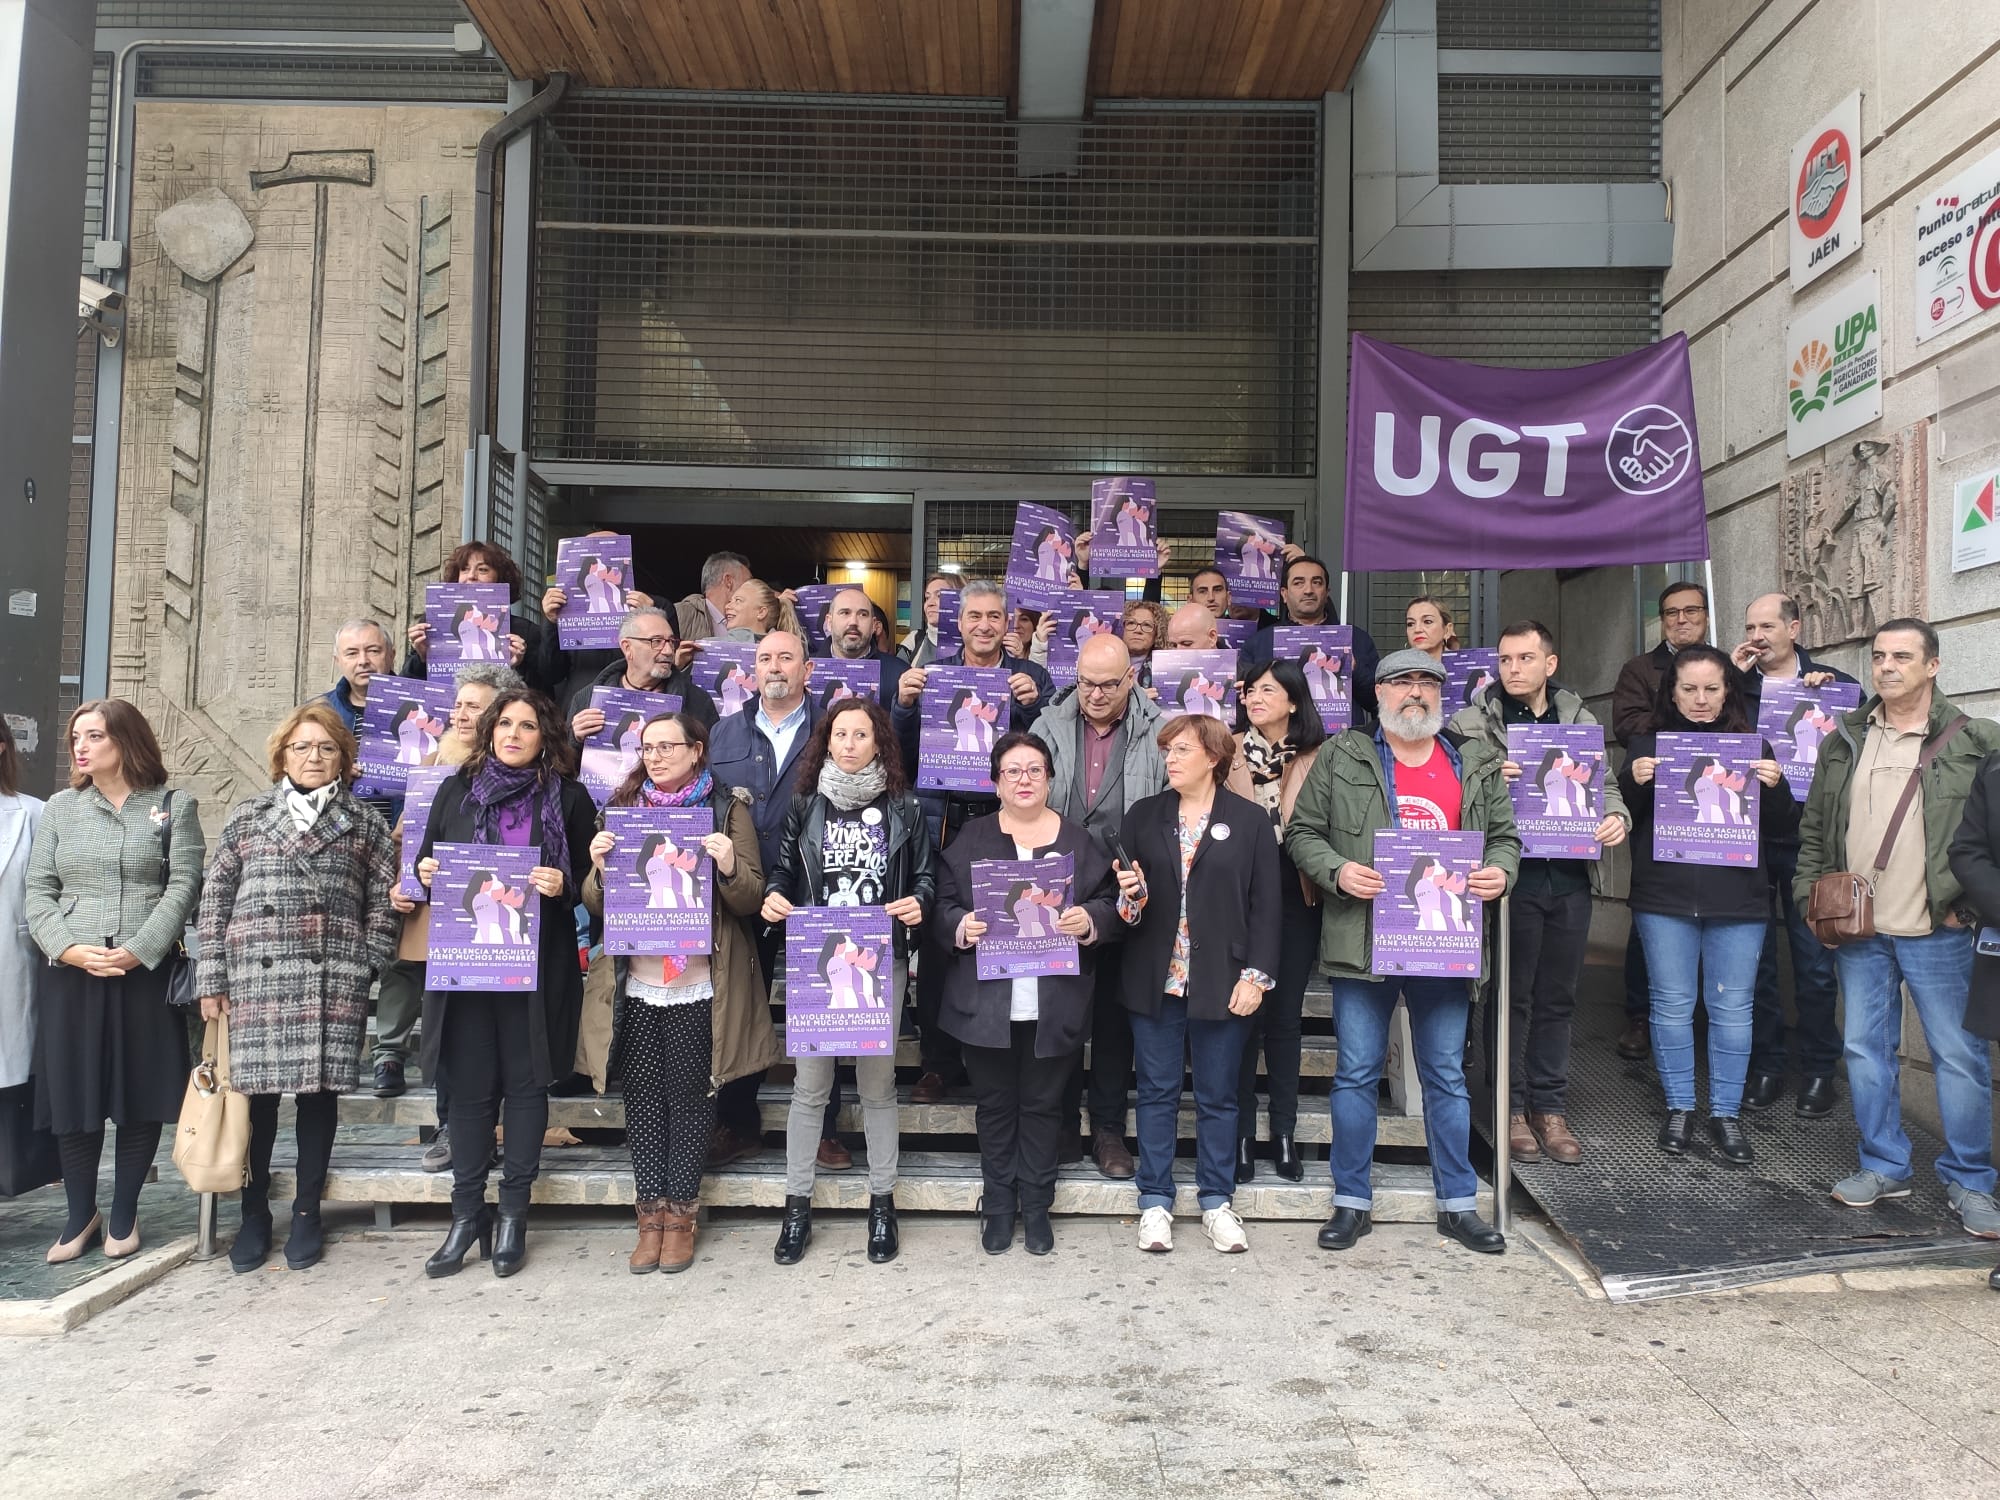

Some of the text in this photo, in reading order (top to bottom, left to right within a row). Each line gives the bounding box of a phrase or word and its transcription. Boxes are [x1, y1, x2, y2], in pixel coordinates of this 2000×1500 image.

[1918, 209, 1953, 241] Punto
[1808, 233, 1840, 268] JAÉN
[1918, 230, 1962, 267] acceso
[1966, 224, 1973, 237] a
[1834, 303, 1877, 352] UPA
[1834, 355, 1877, 386] AGRICULTORES
[1839, 366, 1876, 392] GANADEROS
[1374, 412, 1587, 498] UGT
[369, 763, 407, 772] VIOLENCIA
[381, 769, 408, 777] MUCHO
[826, 821, 873, 855] VIVAS
[1400, 818, 1436, 830] CENTES
[1668, 825, 1711, 833] VIOLENCIA
[823, 848, 887, 877] EREMOS
[442, 947, 489, 955] VIOLENCIA
[1035, 936, 1075, 944] MACHISTA
